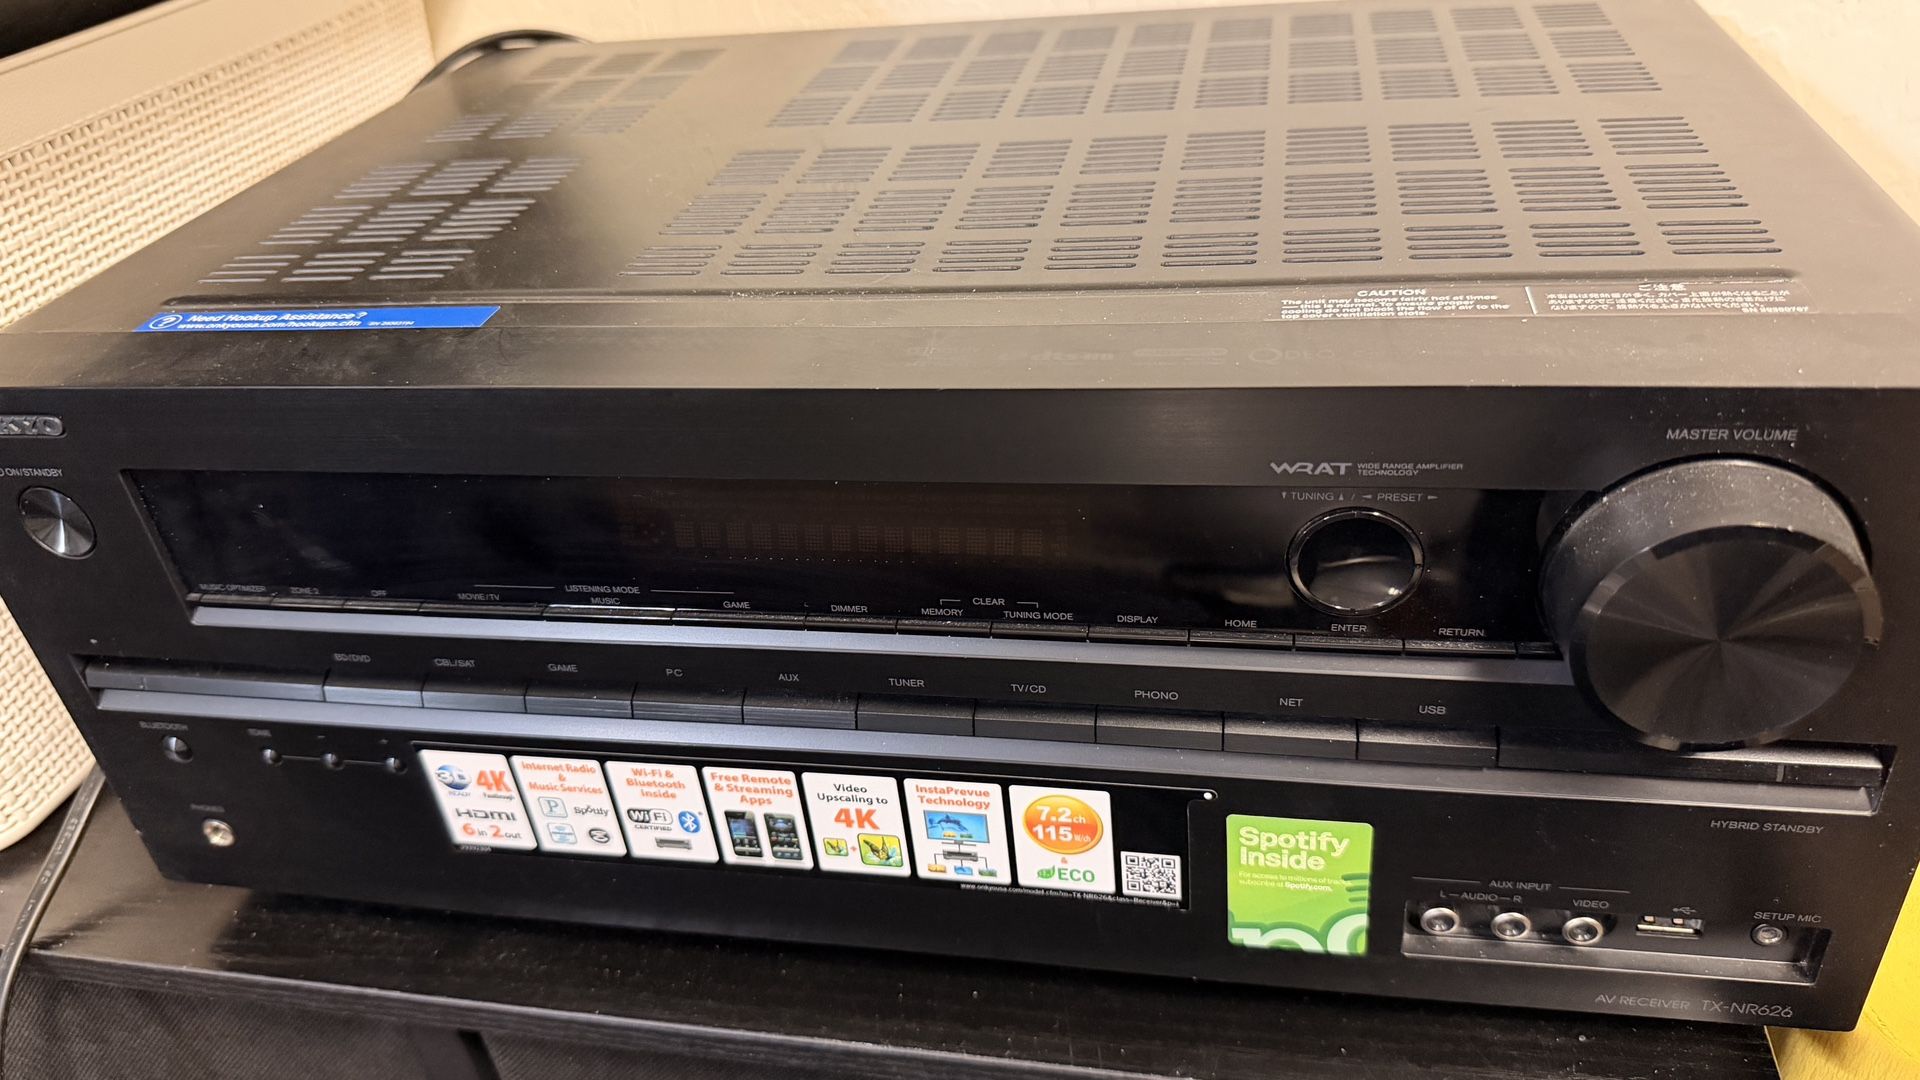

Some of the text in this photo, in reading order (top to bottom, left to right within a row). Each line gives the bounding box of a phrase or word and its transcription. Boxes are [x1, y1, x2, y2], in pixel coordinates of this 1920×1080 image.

[1356, 288, 1427, 297] CAUTION
[187, 310, 369, 323] Need Hookup Assistance?
[177, 318, 362, 330] www.onkyousa.com/hookups.cfm
[1666, 428, 1799, 441] MASTER VOLUME
[5, 467, 63, 477] ON/STANDBY
[1270, 461, 1352, 476] WRAT
[1415, 463, 1464, 471] AMPLIFIER
[1357, 469, 1419, 477] TECHNOLOGY
[1290, 491, 1334, 501] TUNING
[1377, 493, 1424, 502] PRESET
[370, 589, 388, 597] OFF
[564, 584, 640, 594] LISTENING MODE
[591, 597, 621, 605] MUSIC
[723, 601, 751, 609] GAME
[972, 597, 1005, 606] CLEAR
[831, 604, 868, 613] DIMMER
[921, 607, 964, 617] MEMORY
[1003, 610, 1073, 621] TUNING MODE
[1117, 614, 1158, 624] DISPLAY
[1224, 619, 1257, 628] HOME
[1331, 624, 1368, 633] ENTER
[1438, 627, 1485, 637] RETURN
[434, 658, 476, 668] CBL/SAT
[547, 663, 578, 673] GAME
[666, 668, 683, 677] PC
[778, 673, 799, 682] AUX
[888, 677, 925, 688] TUNER
[1011, 683, 1047, 694] TV/CD
[1134, 689, 1179, 700] PHONO
[1279, 697, 1303, 707] NET
[1418, 704, 1447, 715] USB
[521, 761, 596, 774] Internet Radio
[631, 767, 675, 779] Wi-Fi &
[476, 770, 513, 792] 4K
[558, 774, 567, 782] &
[711, 771, 792, 785] Free Remote
[528, 781, 604, 795] Music Services
[626, 778, 686, 790] Bluetooth
[714, 782, 793, 797] & Streaming
[833, 783, 868, 793] Video
[641, 788, 677, 799] Inside
[915, 784, 990, 798] InstaPrevue
[740, 794, 773, 806] Apps
[817, 792, 889, 805] Upscaling to
[917, 795, 991, 810] Technology
[455, 808, 518, 822] HDMI
[574, 805, 610, 818] Spotify
[834, 807, 880, 830] 4K
[462, 822, 523, 840] 6 in 2 out
[1710, 820, 1824, 834] HYBRID STANDBY
[1238, 826, 1349, 857] Spotify
[1240, 847, 1325, 870] Inside
[1057, 868, 1096, 883] ECO
[1488, 880, 1552, 891] AUX INPUT
[1439, 890, 1523, 903] L AUDIO R
[1572, 899, 1610, 909] VIDEO
[1753, 911, 1822, 923] SETUP MIC
[1595, 994, 1794, 1019] AV RECEIVER TX-NR626
